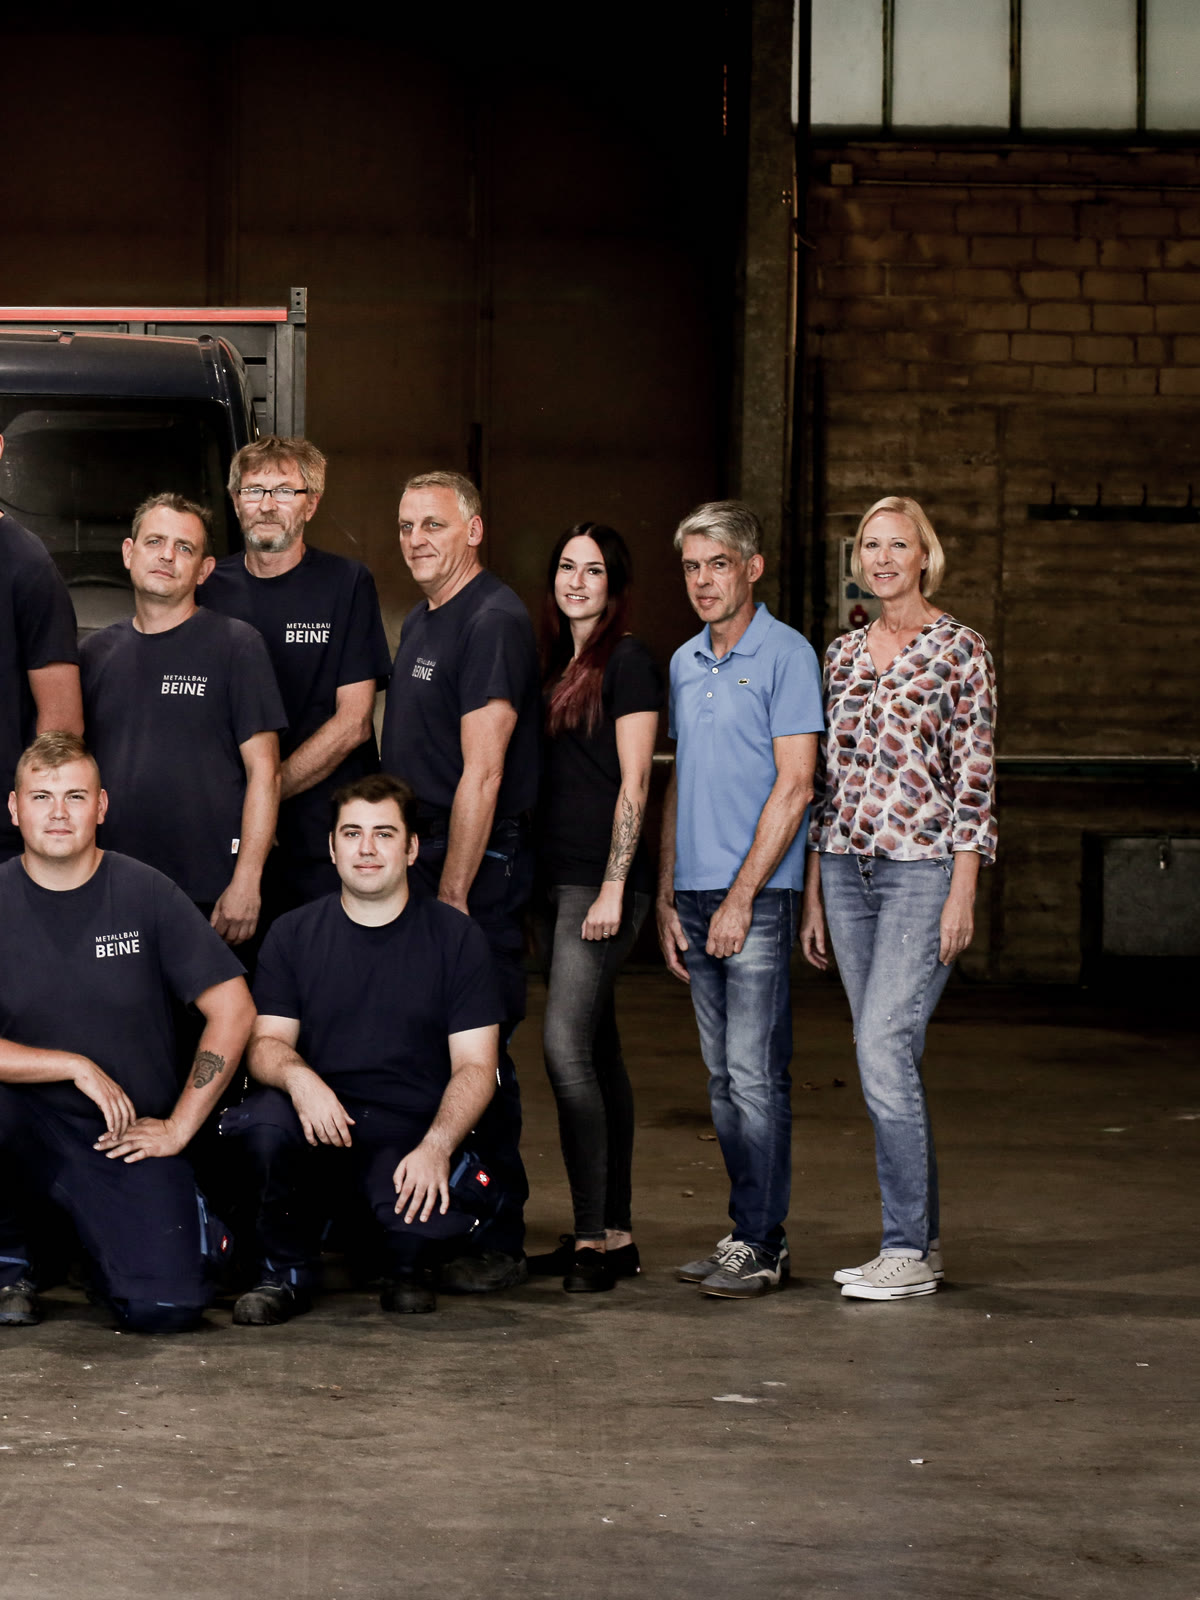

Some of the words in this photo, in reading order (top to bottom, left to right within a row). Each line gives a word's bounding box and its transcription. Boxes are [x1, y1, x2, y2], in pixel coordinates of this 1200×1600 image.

[286, 622, 331, 630] METALLBAU
[285, 630, 330, 643] BEINE
[163, 674, 208, 684] METALLBAU
[411, 664, 434, 681] BEINE
[161, 682, 206, 697] BEINE
[95, 931, 139, 943] METALLBAU
[95, 939, 140, 959] BEINE
